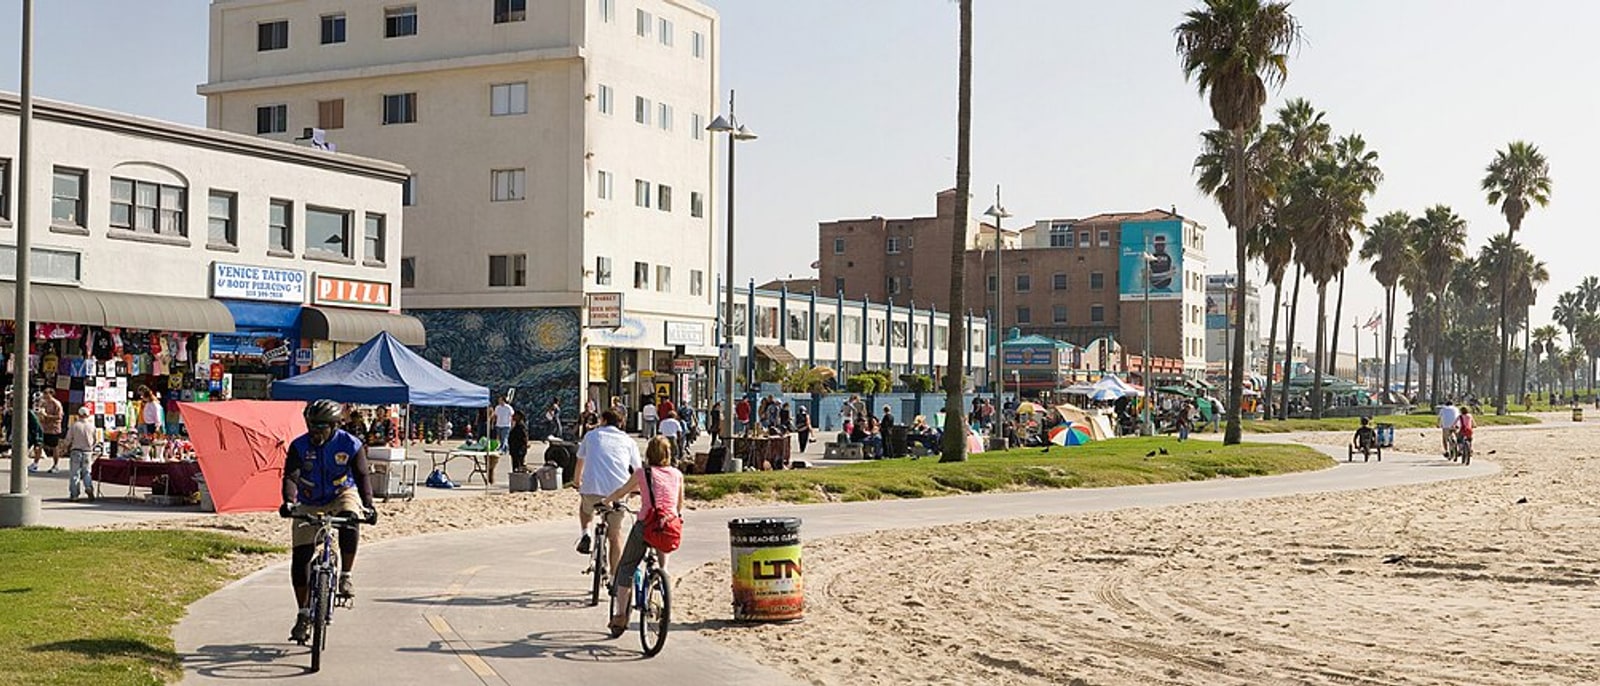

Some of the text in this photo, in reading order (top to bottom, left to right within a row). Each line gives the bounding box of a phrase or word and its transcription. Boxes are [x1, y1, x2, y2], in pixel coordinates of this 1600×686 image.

[218, 265, 302, 283] VENICE TATTOO
[217, 279, 226, 287] &
[227, 280, 250, 289] BODY
[252, 281, 292, 292] PIERCING
[321, 279, 386, 304] PIZZA
[749, 535, 780, 543] BEACHES
